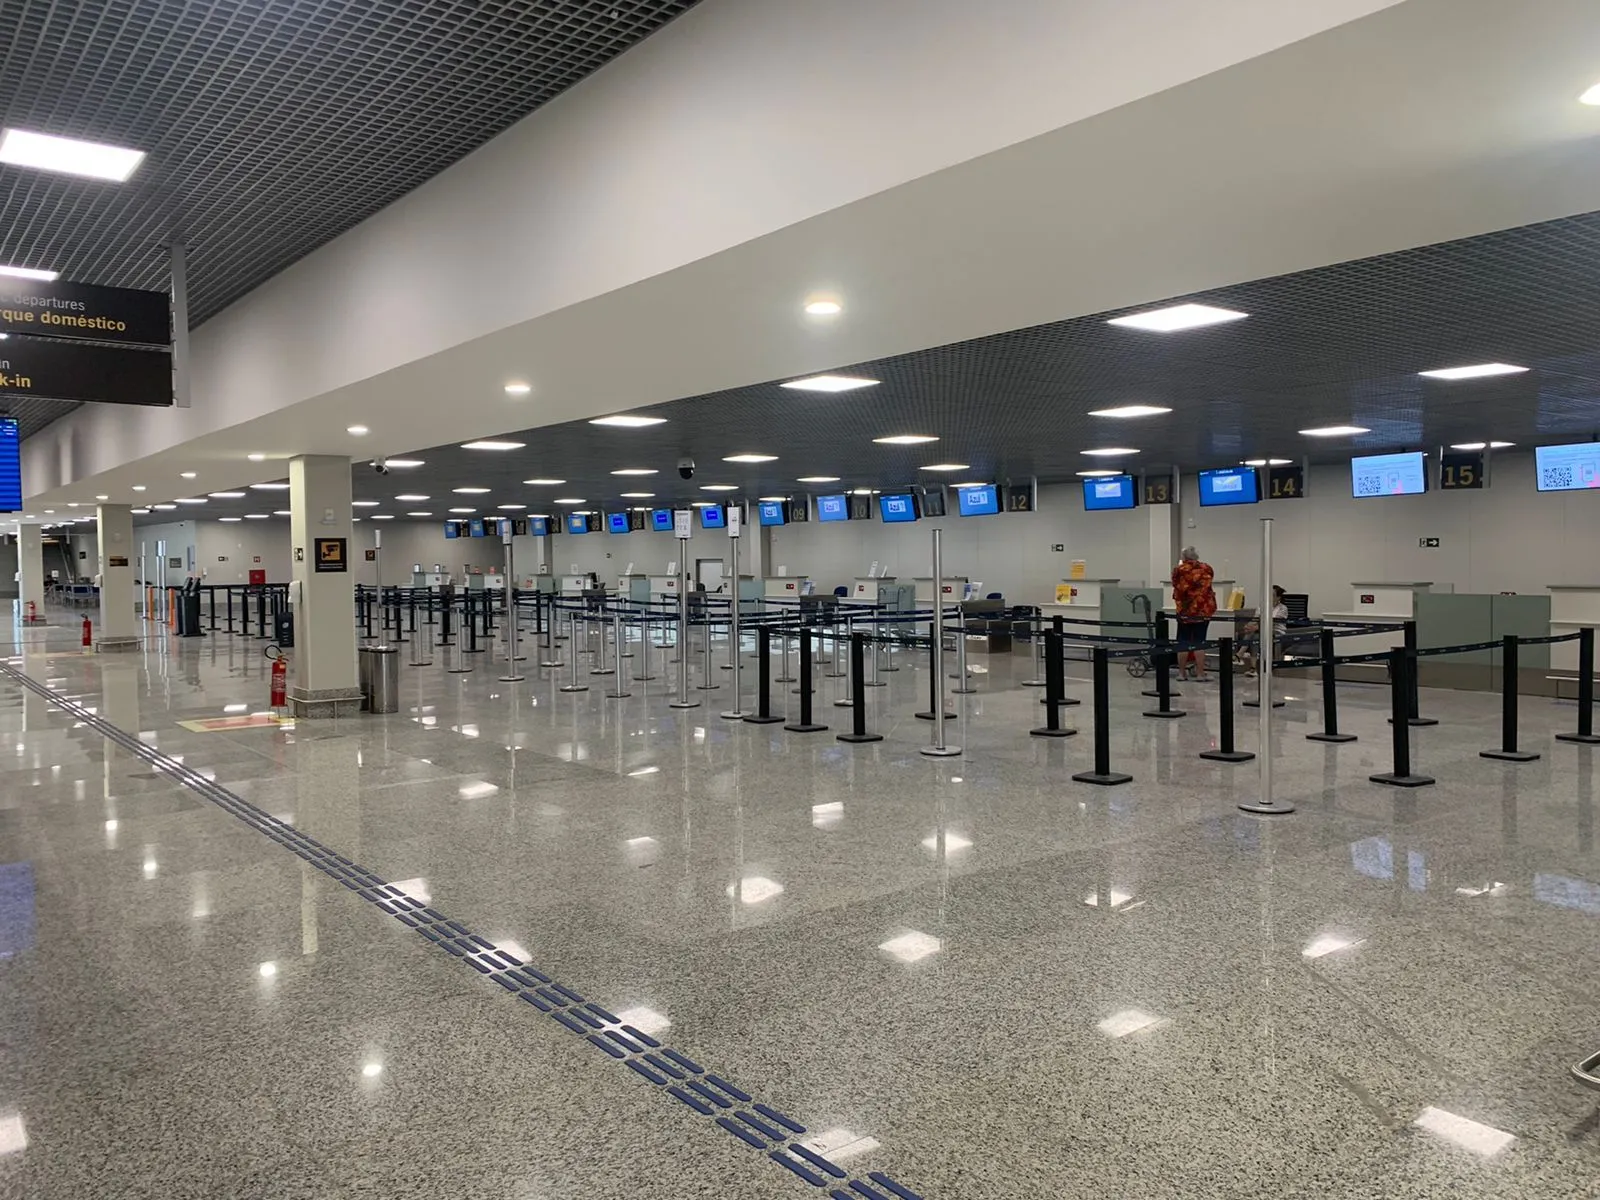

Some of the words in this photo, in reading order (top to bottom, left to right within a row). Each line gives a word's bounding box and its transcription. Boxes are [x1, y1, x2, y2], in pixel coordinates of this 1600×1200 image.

[14, 295, 86, 311] departures
[0, 309, 35, 323] que
[40, 311, 126, 331] doméstico
[1444, 465, 1474, 486] 15
[1146, 486, 1168, 501] 13
[1271, 478, 1296, 496] 14
[1011, 495, 1027, 510] 12
